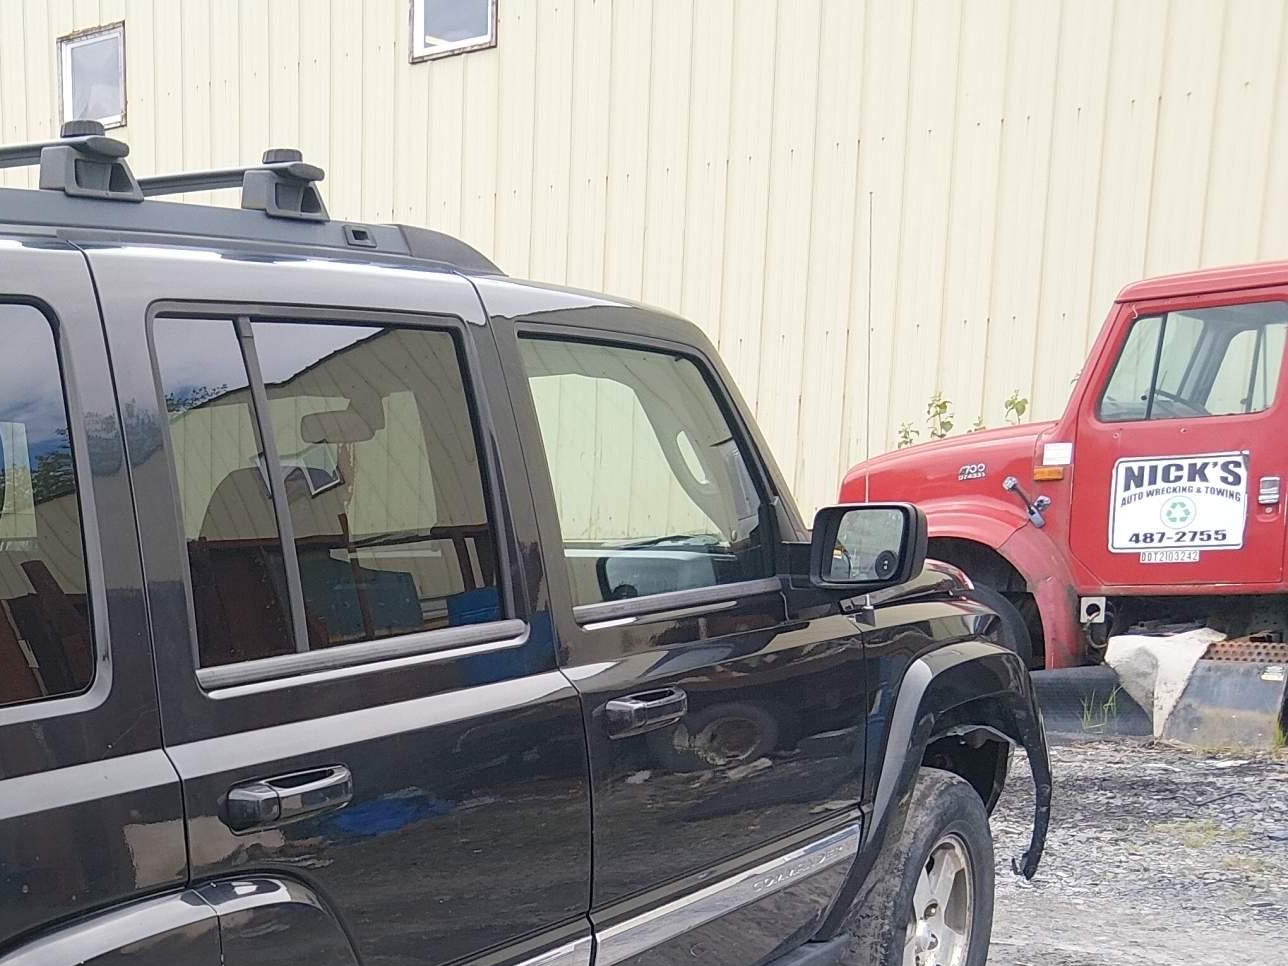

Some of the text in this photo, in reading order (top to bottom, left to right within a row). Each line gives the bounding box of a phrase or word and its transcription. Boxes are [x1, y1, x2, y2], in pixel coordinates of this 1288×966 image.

[1123, 460, 1242, 492] NICK'S
[1120, 485, 1242, 508] AUTO WRECKING & TOWING
[1128, 529, 1227, 544] 487-2755
